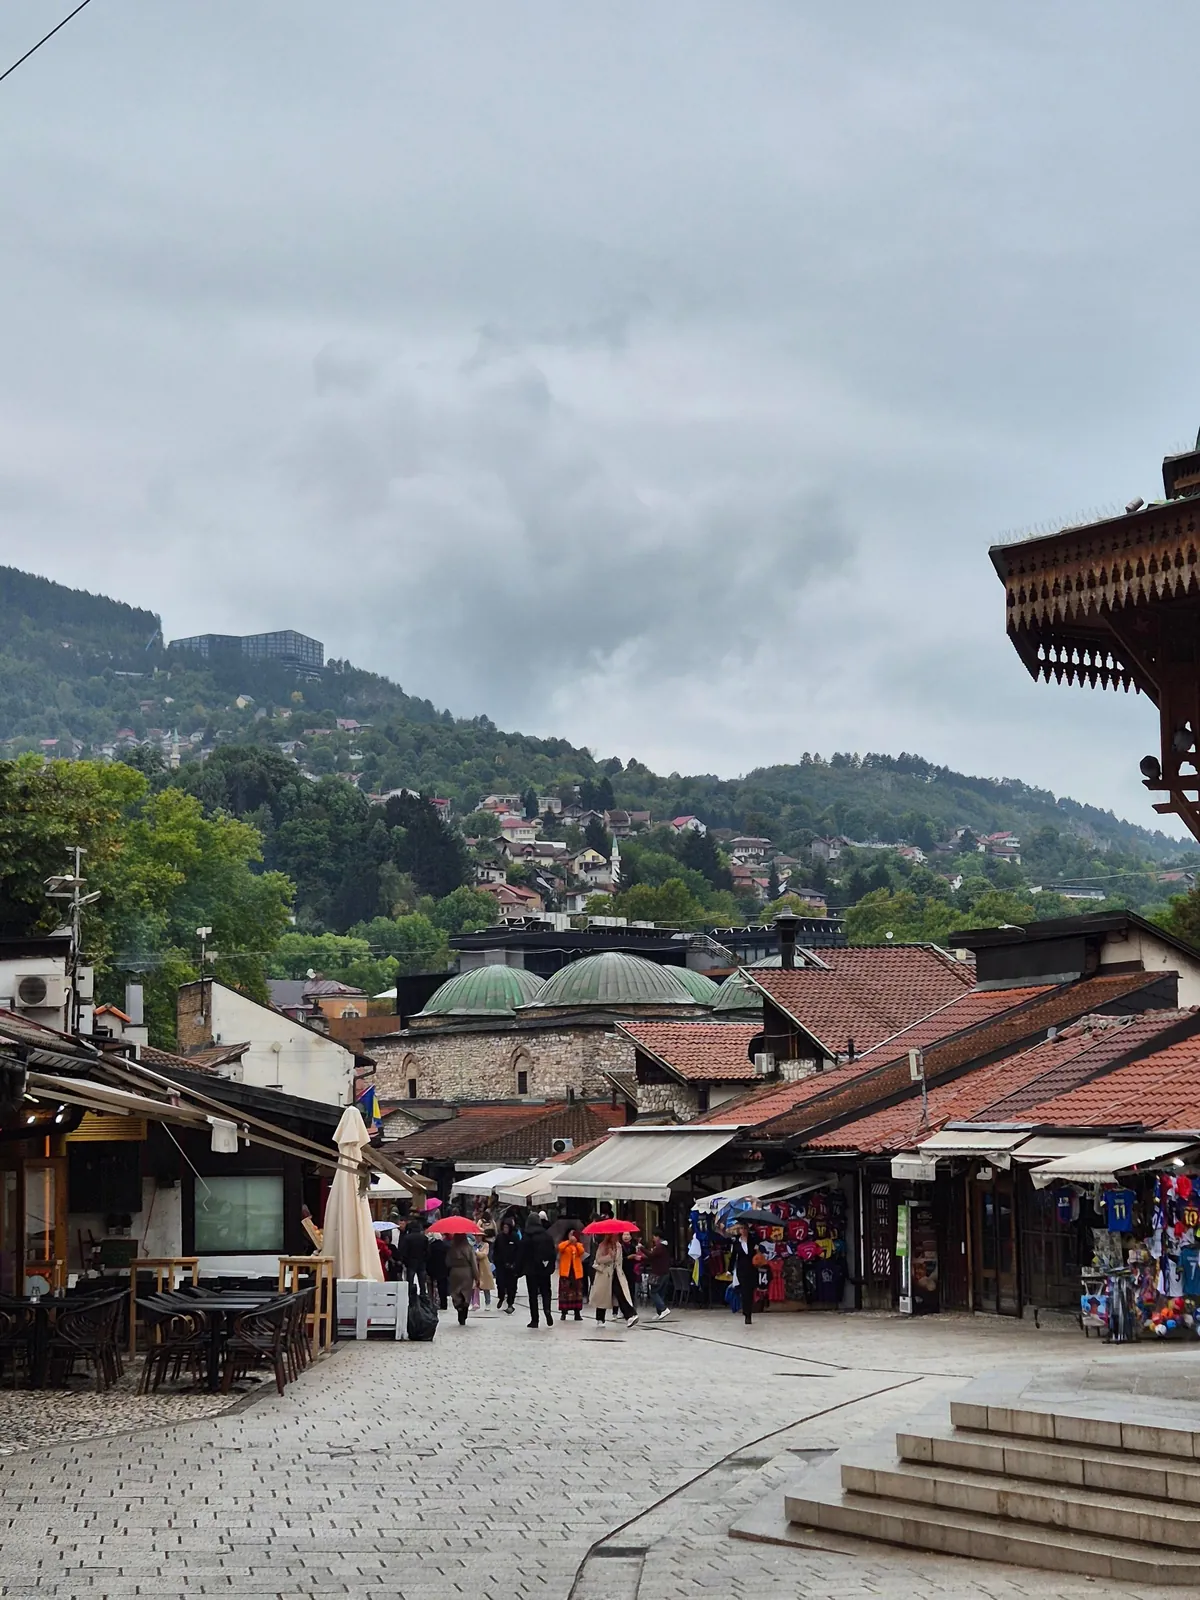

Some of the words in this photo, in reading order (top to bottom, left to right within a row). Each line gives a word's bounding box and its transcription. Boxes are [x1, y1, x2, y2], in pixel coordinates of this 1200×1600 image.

[1113, 1204, 1126, 1220] 11
[1184, 1210, 1199, 1227] 10
[697, 1220, 708, 1232] 11
[758, 1272, 769, 1286] 14
[1189, 1262, 1197, 1281] 7
